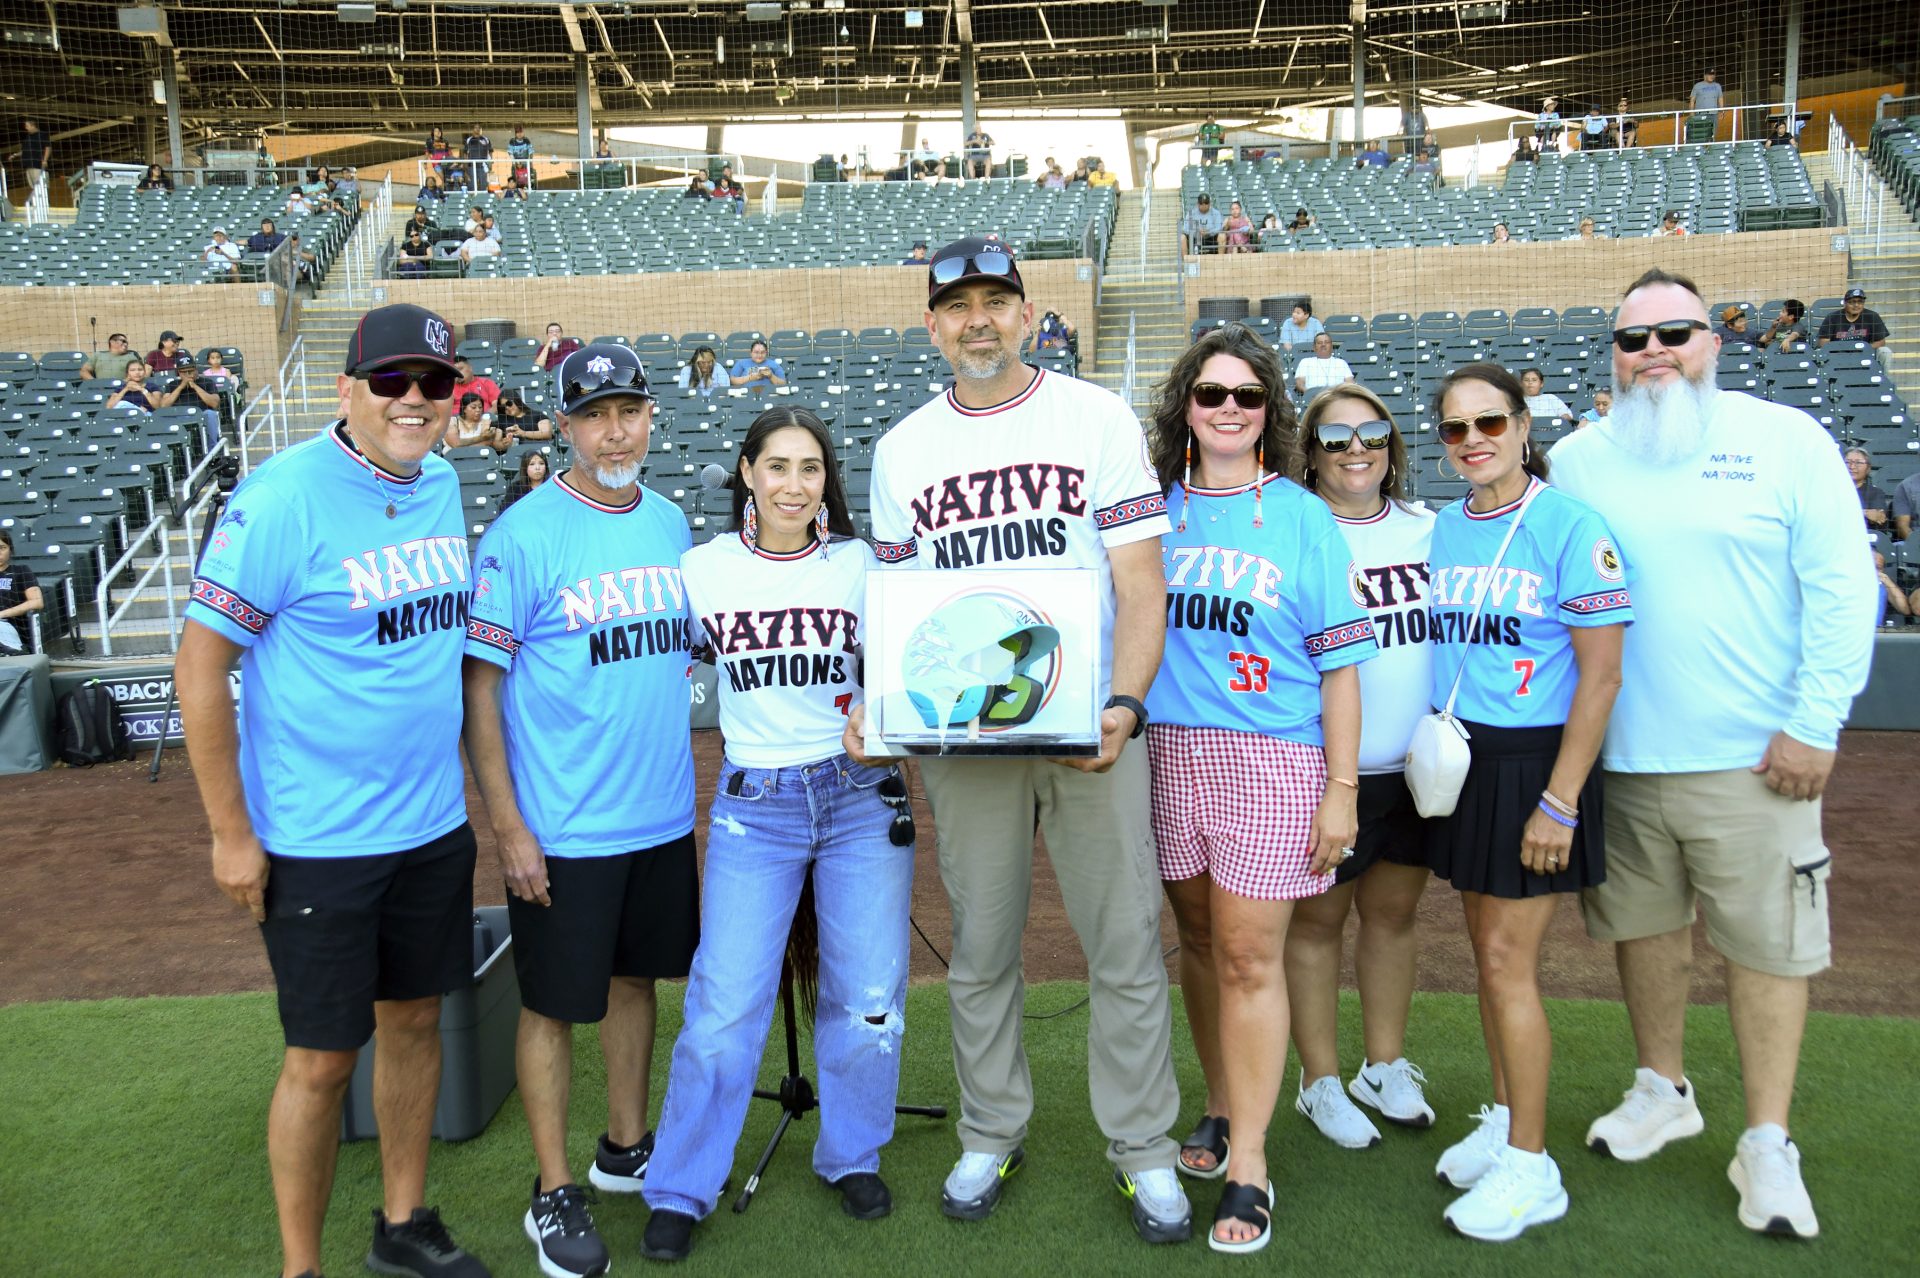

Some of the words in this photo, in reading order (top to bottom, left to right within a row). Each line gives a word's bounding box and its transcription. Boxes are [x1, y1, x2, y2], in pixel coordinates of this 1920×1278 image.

[910, 462, 1087, 539] NA7IVE
[933, 517, 1067, 569] NA7IONS
[341, 535, 468, 611] NA7IV
[559, 565, 684, 633] NA7IV
[1162, 545, 1284, 609] 7IVE
[1430, 565, 1544, 618] A7IVE
[377, 591, 475, 646] NA7ION
[701, 608, 861, 656] NA7IVE
[724, 653, 848, 693] NA7IONS
[1227, 650, 1271, 693] 33
[1513, 658, 1536, 697] 7
[834, 692, 853, 718] 7
